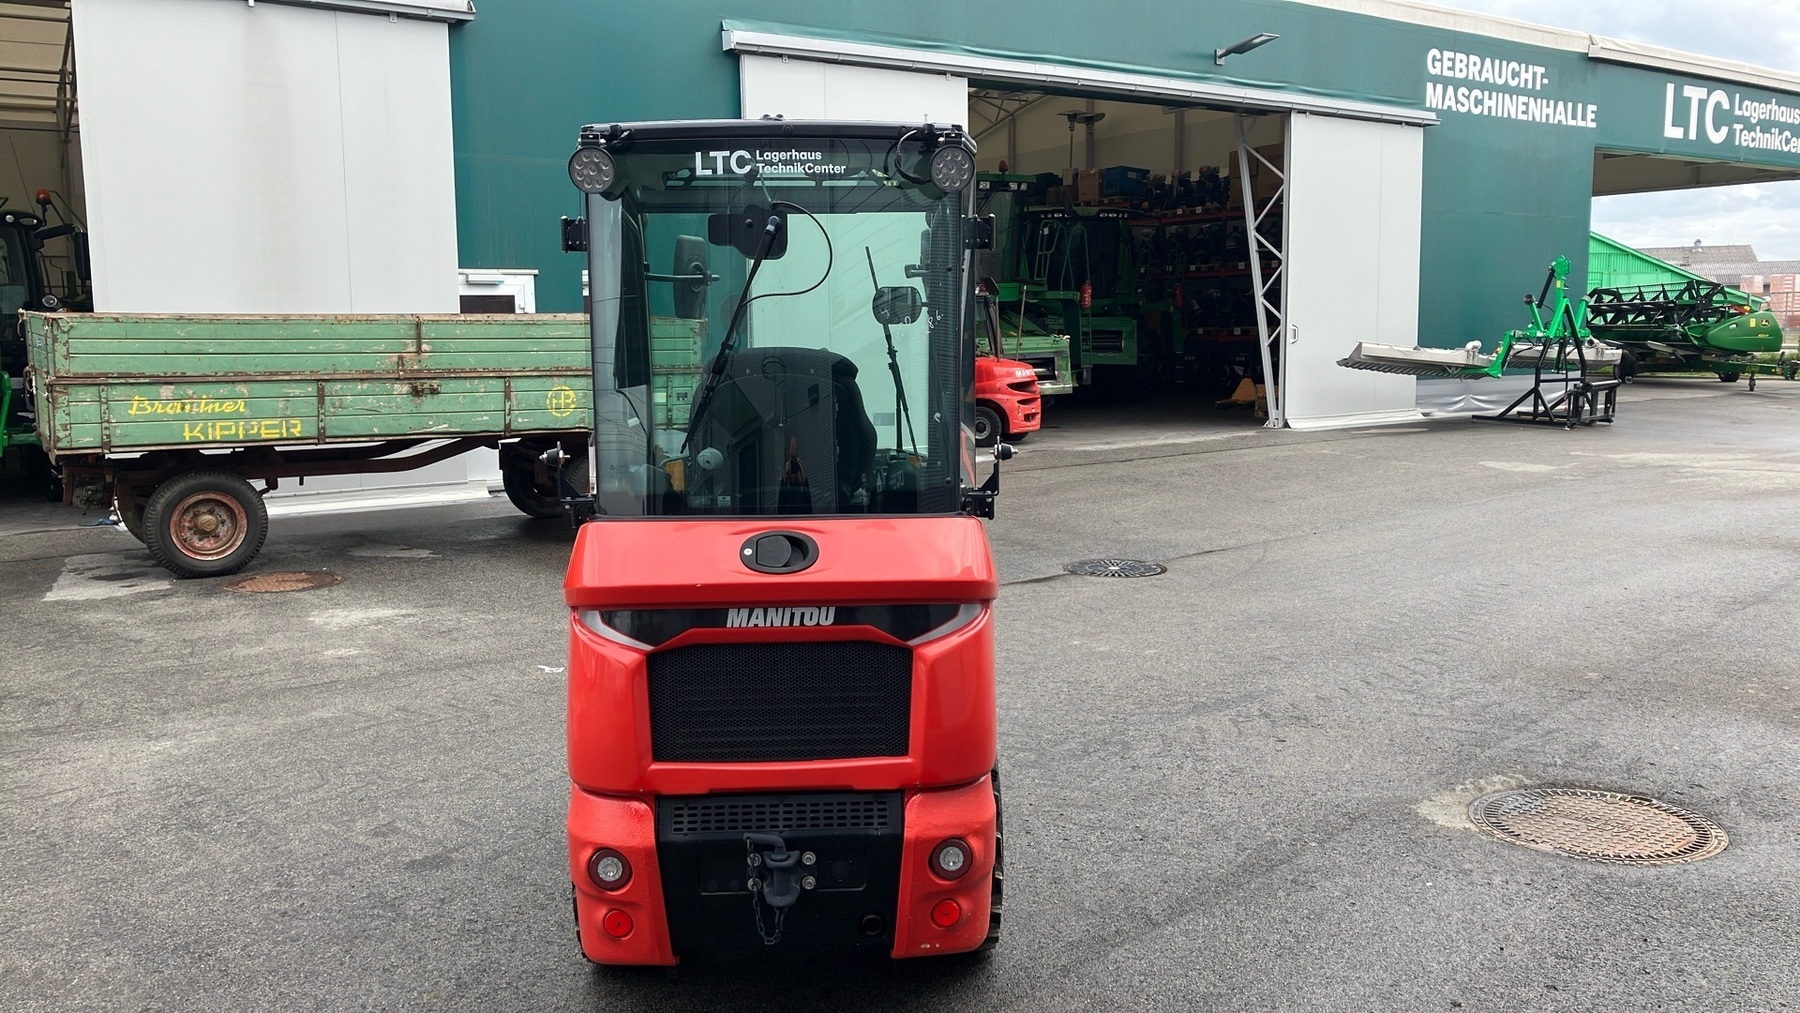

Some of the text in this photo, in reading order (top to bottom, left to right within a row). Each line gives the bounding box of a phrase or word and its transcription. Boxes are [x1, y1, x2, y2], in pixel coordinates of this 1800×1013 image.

[1427, 48, 1549, 90] GEBRAUCHT-
[1426, 82, 1597, 128] MASCHINENHALLE
[1664, 82, 1800, 144] LTC Lagerhaus
[695, 149, 822, 176] LTC Lagerhaus
[756, 163, 847, 174] TechnikCenter
[726, 606, 836, 628] MANITOU
